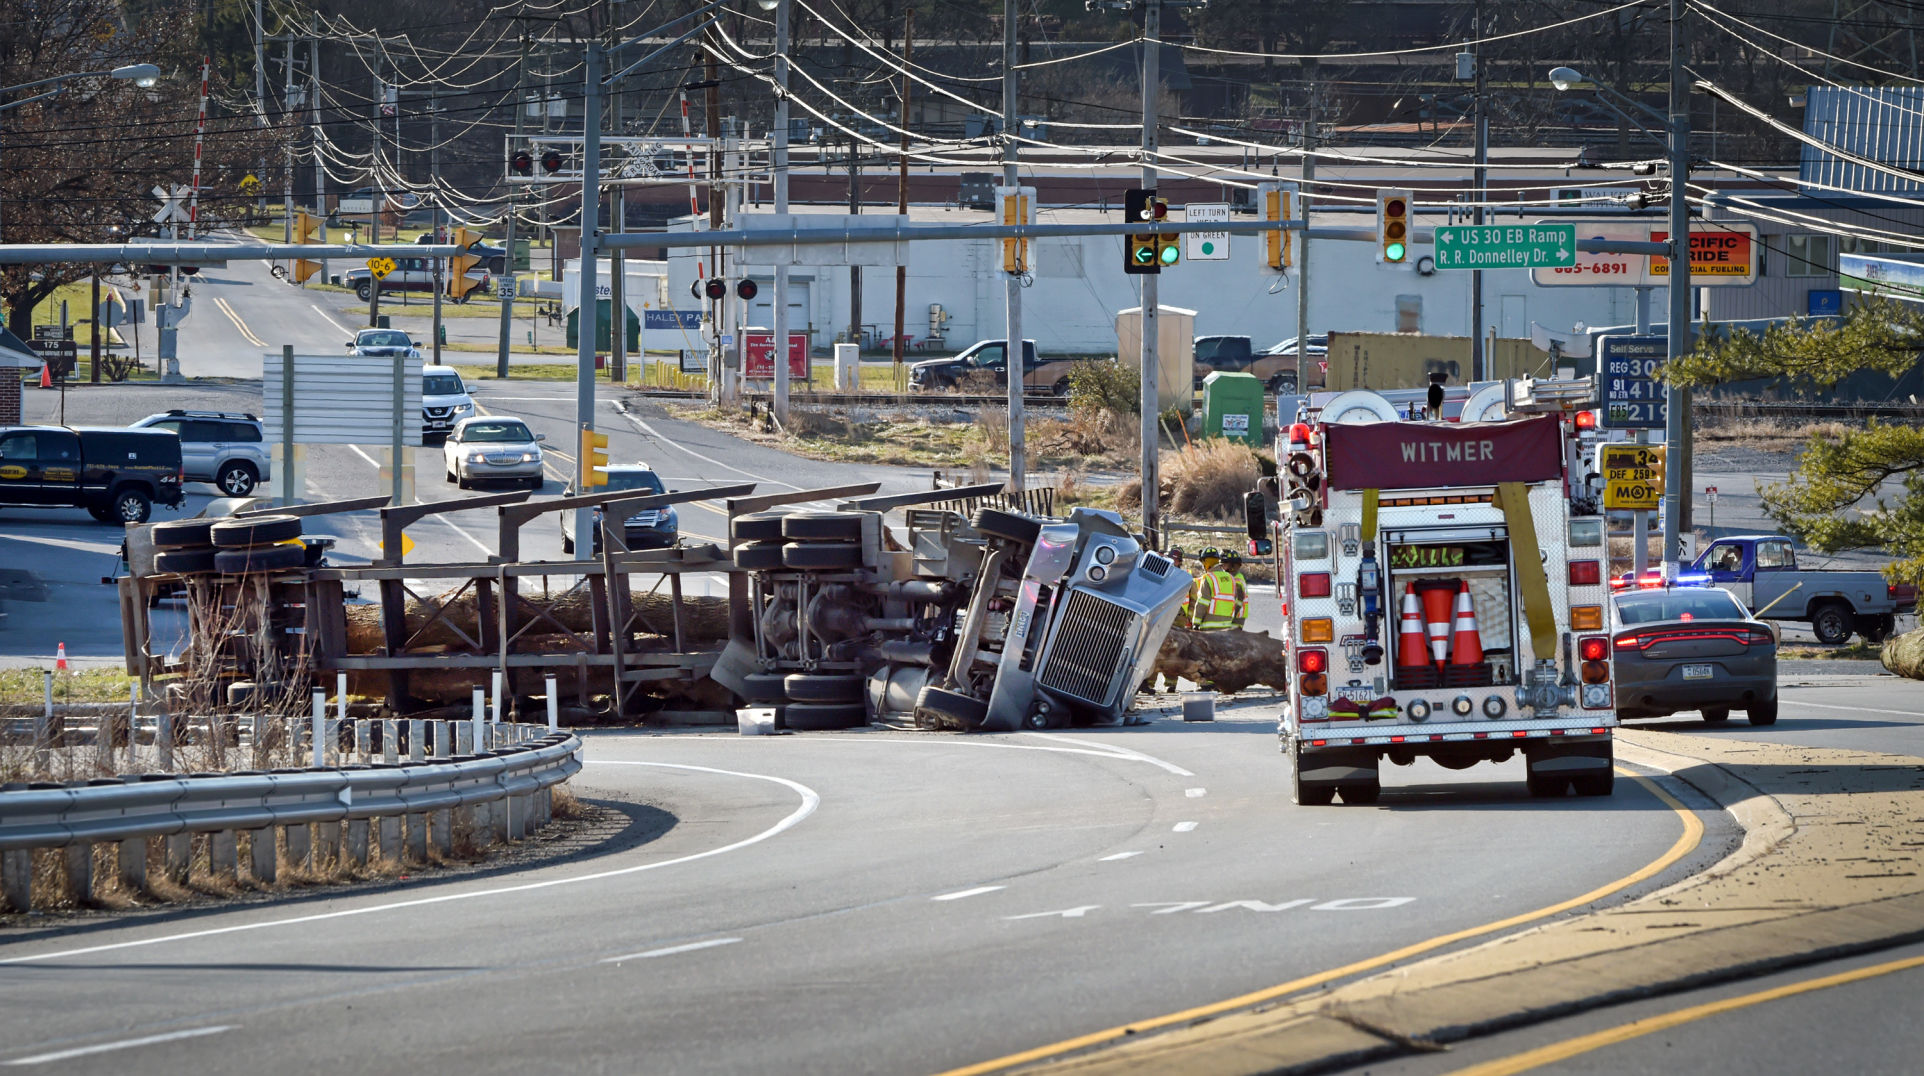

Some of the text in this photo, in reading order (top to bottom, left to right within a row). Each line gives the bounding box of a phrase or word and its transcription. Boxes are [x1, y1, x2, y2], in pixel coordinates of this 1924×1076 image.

[1203, 231, 1226, 239] GREEN
[1461, 229, 1567, 246] US 30 EB Ramp
[1689, 237, 1737, 249] CIFIC
[1440, 248, 1549, 266] R. R. Donnelley Dr.
[1689, 250, 1729, 262] RIDE
[500, 287, 514, 297] 35
[646, 313, 682, 322] HALEY
[44, 341, 59, 349] 175
[1610, 345, 1655, 354] Self Serve
[1610, 361, 1629, 374] REG
[1613, 379, 1625, 391] 91
[1610, 404, 1627, 418] E85
[1400, 440, 1494, 463] WITMER
[1610, 469, 1627, 480] DEF
